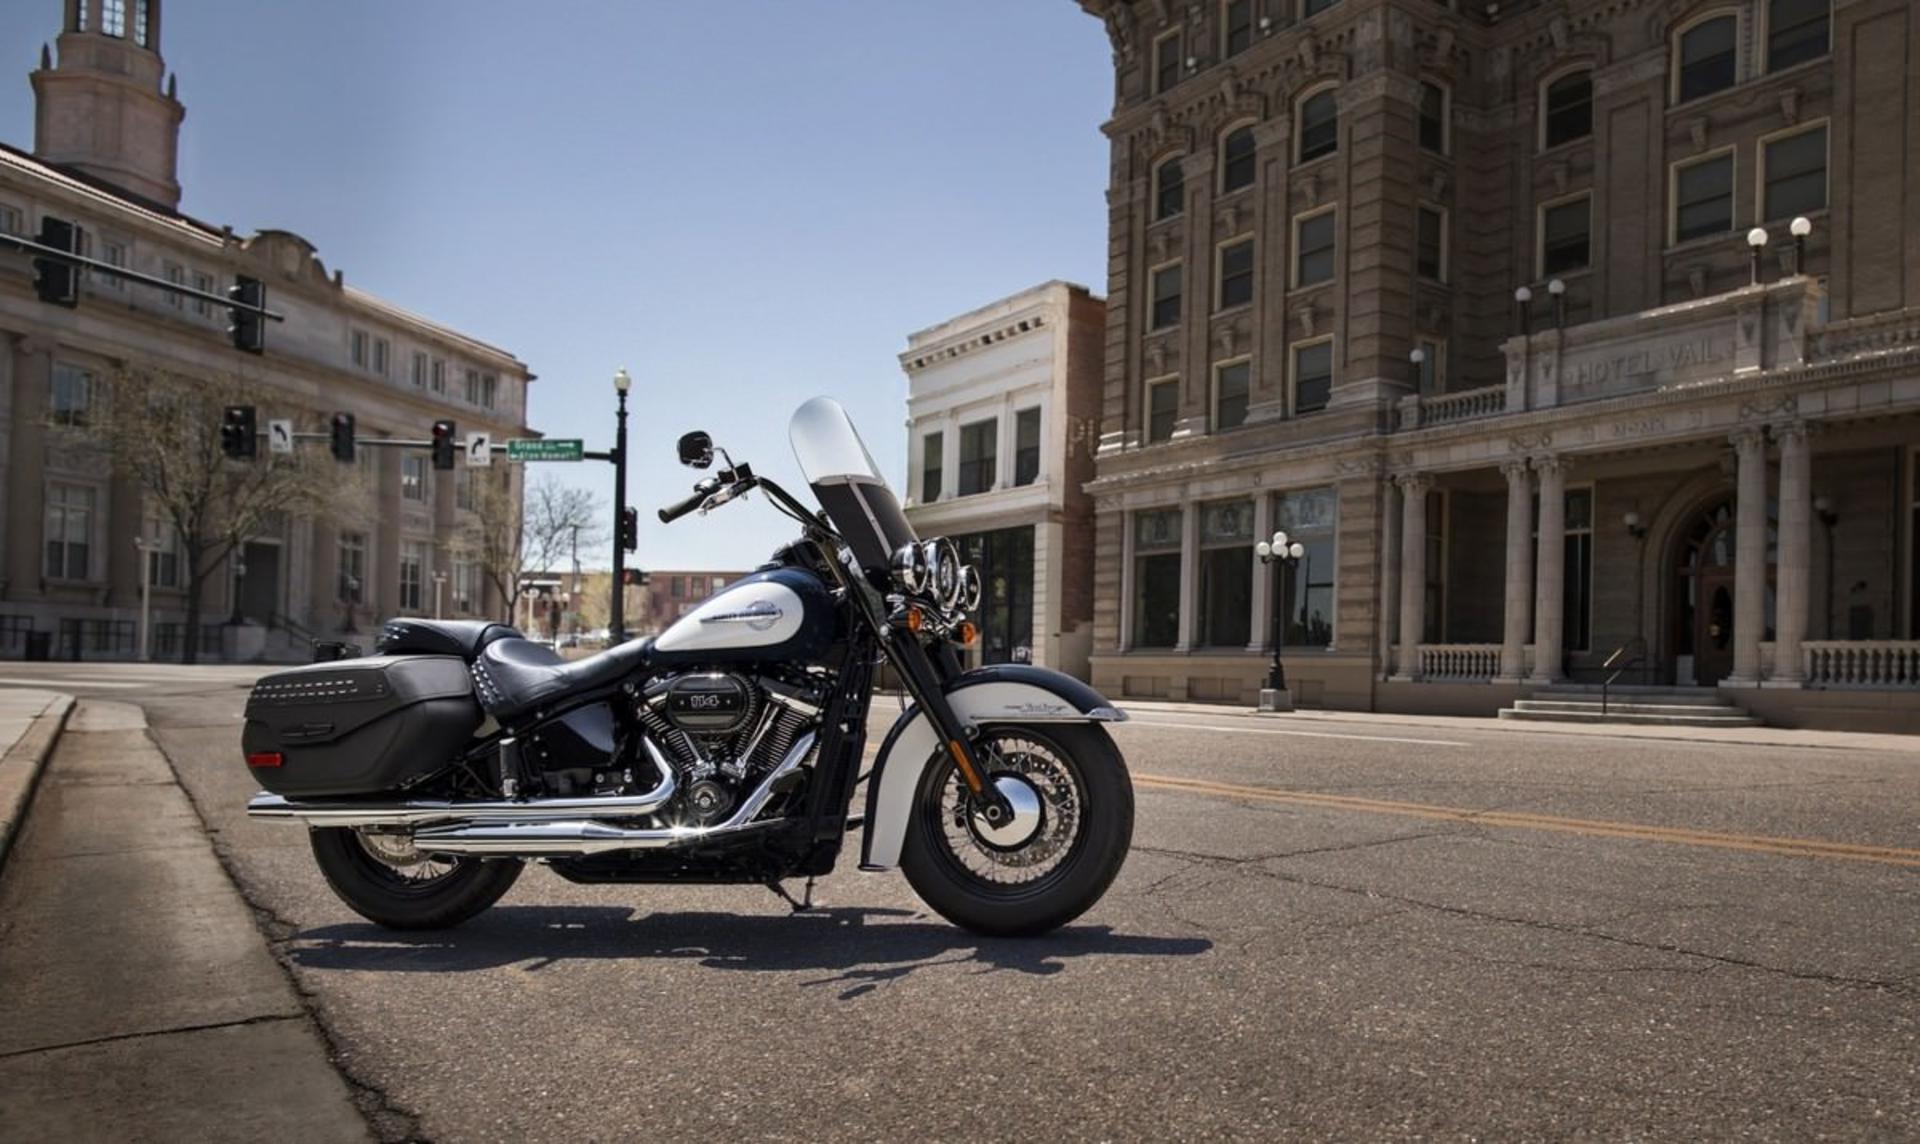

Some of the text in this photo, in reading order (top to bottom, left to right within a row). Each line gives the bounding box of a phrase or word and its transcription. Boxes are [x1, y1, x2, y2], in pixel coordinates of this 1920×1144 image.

[1579, 337, 1714, 385] HOTEL VAIL
[691, 695, 720, 708] 114
